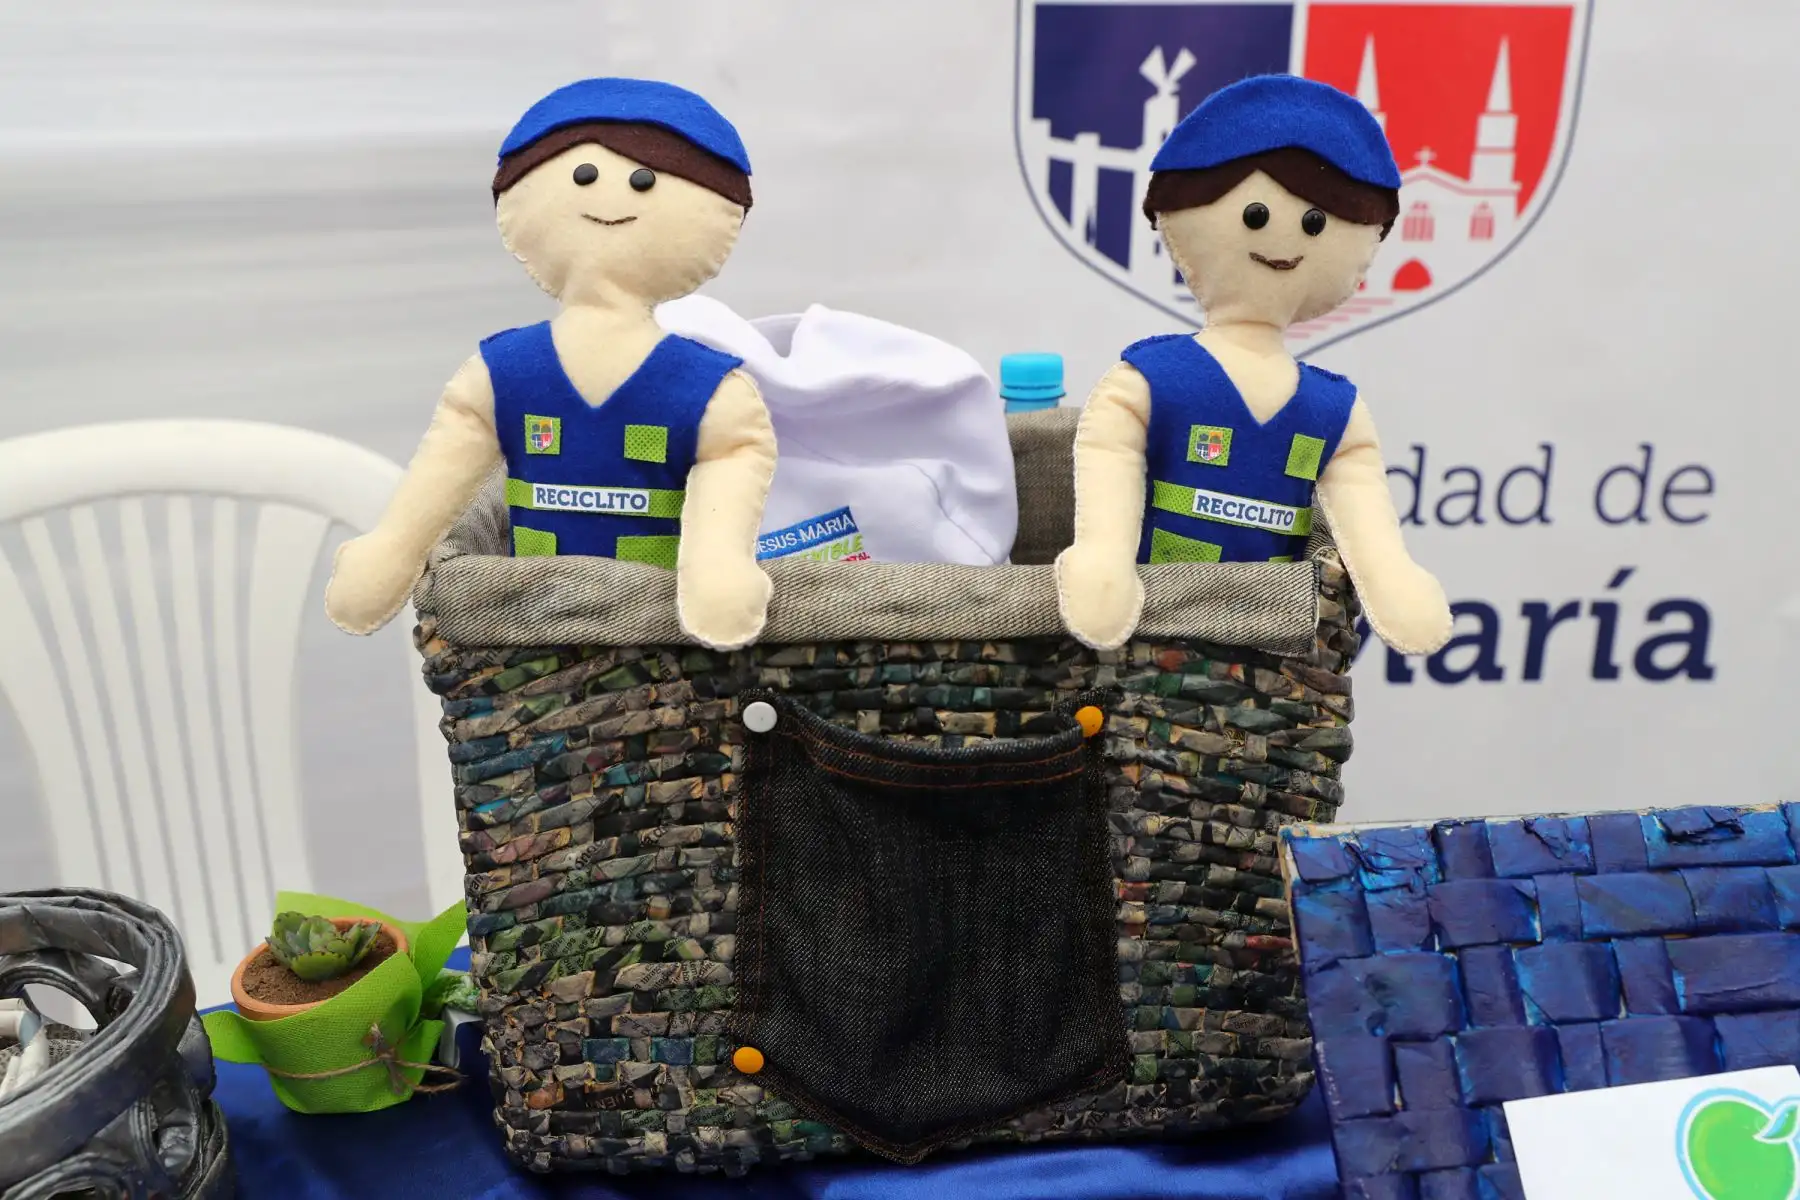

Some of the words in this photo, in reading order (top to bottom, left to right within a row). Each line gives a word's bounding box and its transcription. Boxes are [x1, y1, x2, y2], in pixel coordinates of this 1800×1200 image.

[535, 486, 647, 510] RECICLITO
[1593, 442, 1716, 527] de
[1196, 494, 1294, 527] RECICLITO
[798, 513, 856, 543] MARIA
